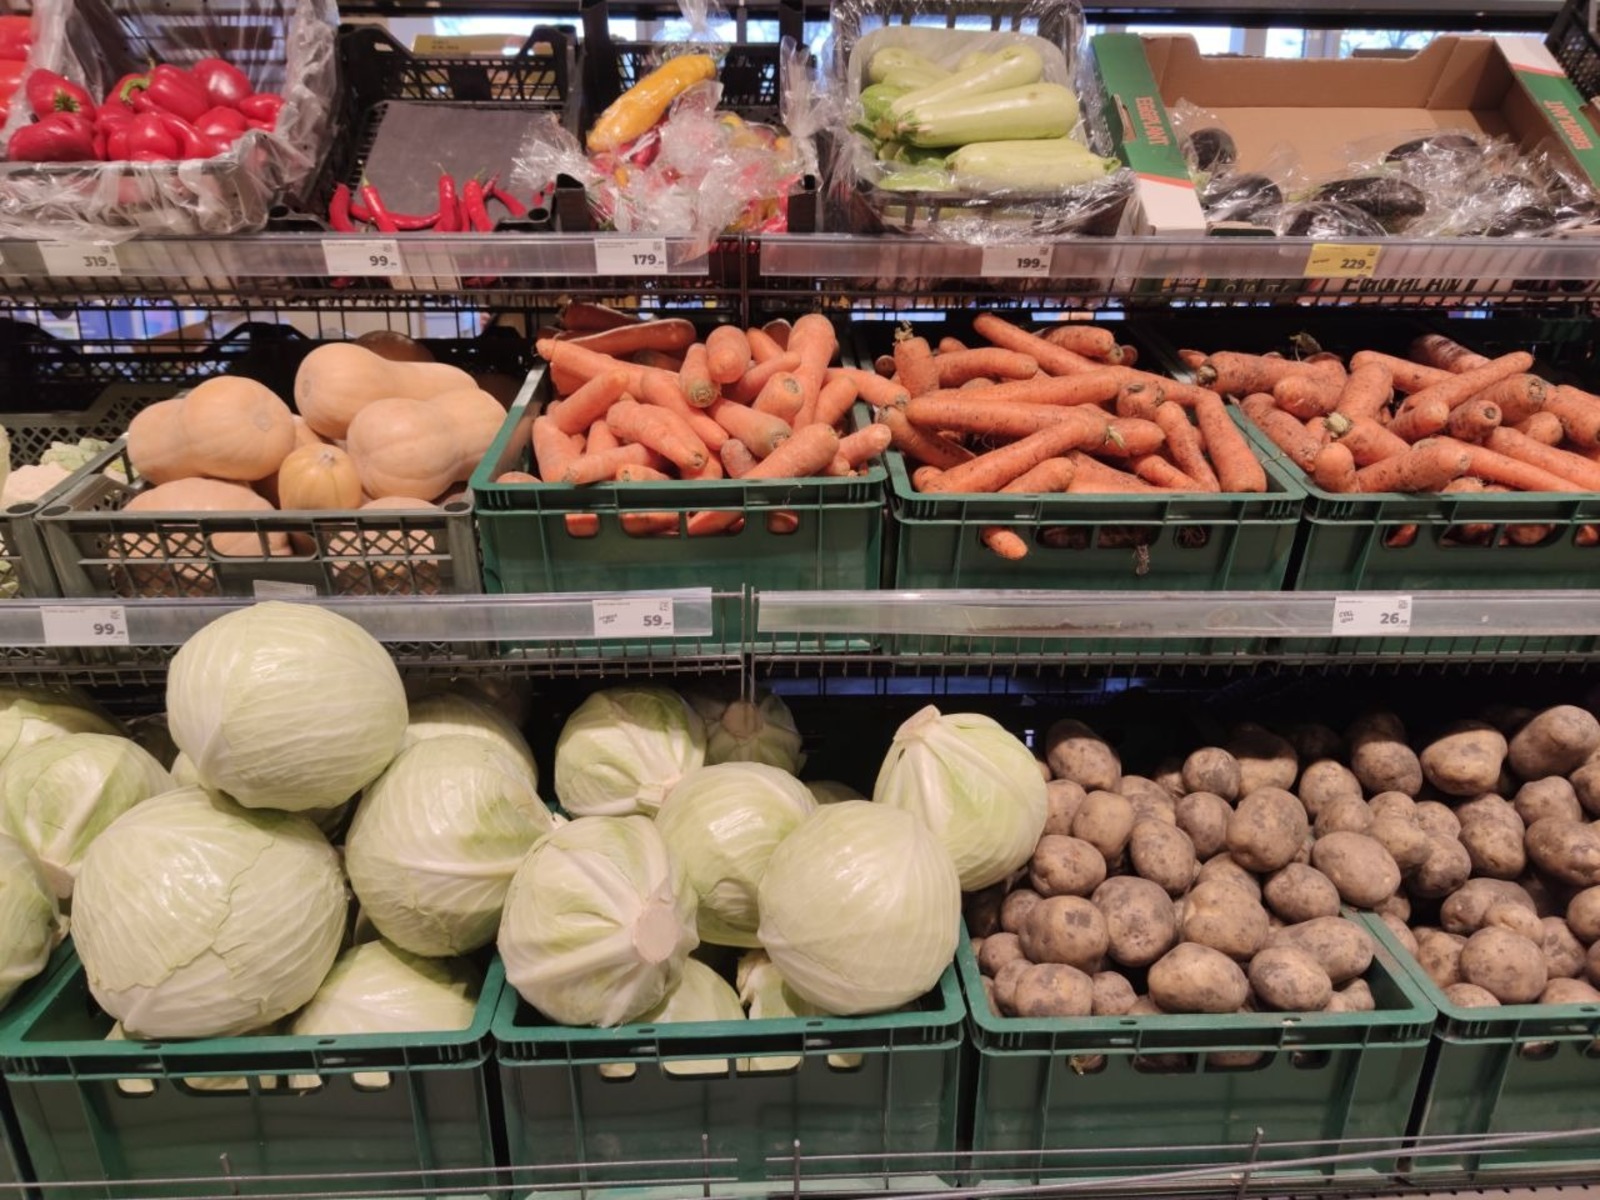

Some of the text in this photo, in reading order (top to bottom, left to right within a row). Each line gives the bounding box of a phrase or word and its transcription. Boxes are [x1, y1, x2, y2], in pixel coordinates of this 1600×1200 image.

[369, 255, 388, 266] 99
[632, 254, 657, 265] 179
[1017, 258, 1040, 268] 199
[1340, 258, 1366, 269] 229
[643, 614, 663, 627] 59
[1380, 613, 1399, 624] 26
[93, 623, 115, 635] 99
